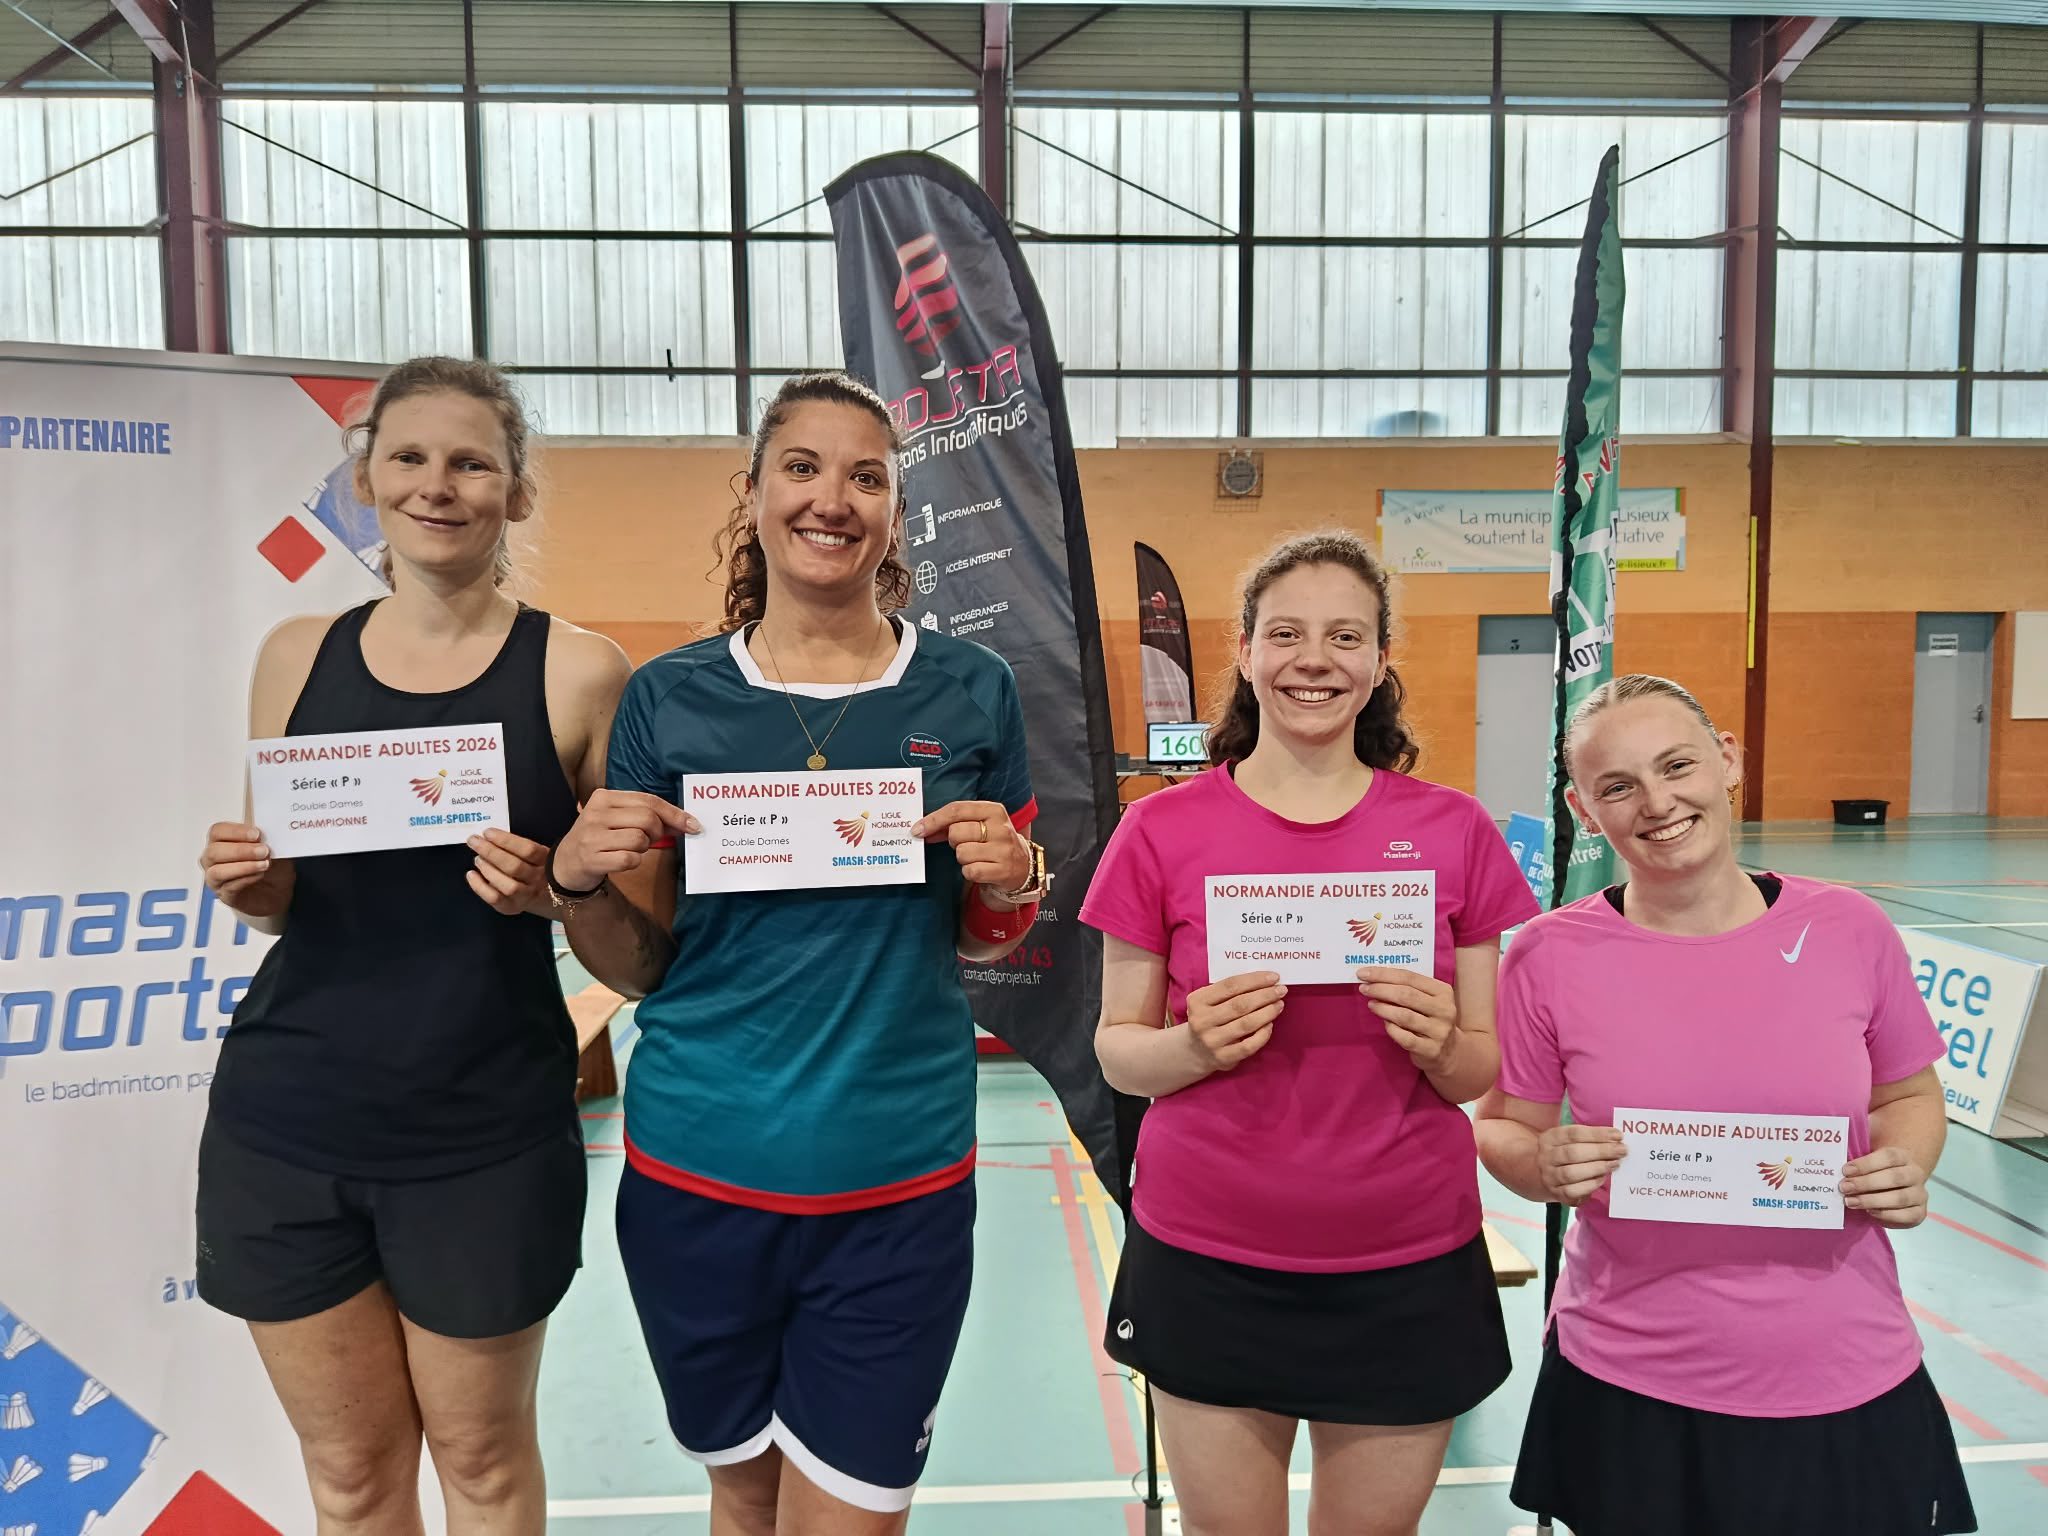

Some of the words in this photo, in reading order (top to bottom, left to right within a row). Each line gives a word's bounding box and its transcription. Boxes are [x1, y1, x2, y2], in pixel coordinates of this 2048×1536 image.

[0, 416, 170, 454] PARTENAIRE
[938, 498, 1002, 524] INFORMATIQUE
[1459, 509, 1478, 524] La
[1617, 507, 1670, 523] Lisieux
[1464, 528, 1527, 545] soutient
[1532, 528, 1544, 544] la
[945, 559, 969, 575] ACCÈS
[970, 548, 1013, 567] INTERNET
[950, 601, 1009, 625] INFOGÉRANCES
[951, 627, 957, 637] &
[957, 618, 994, 636] SERVICES
[257, 744, 372, 765] NORMANDIE
[378, 739, 450, 757] ADULTES
[456, 737, 497, 752] 2026
[1161, 736, 1202, 756] 160
[460, 768, 482, 777] LIGUE
[291, 777, 326, 791] Série
[343, 776, 350, 787] P
[450, 777, 493, 787] NORMANDIE
[692, 783, 800, 800] NORMANDIE
[805, 781, 874, 797] ADULTES
[878, 781, 916, 795] 2026
[291, 801, 328, 812] Double
[330, 799, 363, 809] Dames
[451, 795, 495, 805] BADMINTON
[722, 813, 756, 826] Série
[770, 814, 778, 825] P
[881, 812, 902, 820] LIGUE
[290, 816, 368, 830] CHAMPIONNE
[871, 820, 912, 829] NORMANDIE
[722, 838, 755, 847] Double
[757, 837, 790, 846] Dames
[871, 838, 912, 847] BADMINTON
[719, 854, 793, 865] CHAMPIONNE
[1213, 884, 1315, 898] NORMANDIE
[1320, 884, 1387, 898] ADULTES
[1391, 883, 1429, 897] 2026
[1241, 912, 1272, 924] Série
[1286, 913, 1293, 924] P
[1393, 913, 1414, 921] LIGUE
[1240, 935, 1272, 943] Double
[1274, 935, 1304, 943] Dames
[1384, 939, 1423, 947] BADMINTON
[1224, 950, 1321, 960] VICE-CHAMPIONNE
[1909, 954, 1992, 1016] ace
[26, 1083, 46, 1103] le
[52, 1072, 182, 1101] badminton
[1622, 1119, 1726, 1139] NORMANDIE
[1731, 1125, 1799, 1141] ADULTES
[1803, 1128, 1842, 1143] 2026
[1649, 1149, 1681, 1162] Série
[1695, 1152, 1702, 1162] P
[1804, 1158, 1825, 1167] LIGUE
[1647, 1171, 1679, 1181] Double
[1681, 1173, 1712, 1183] Dames
[1794, 1167, 1835, 1176] NORMANDIE
[1629, 1187, 1729, 1200] VICE-CHAMPIONNE
[1793, 1184, 1834, 1193] BADMINTON
